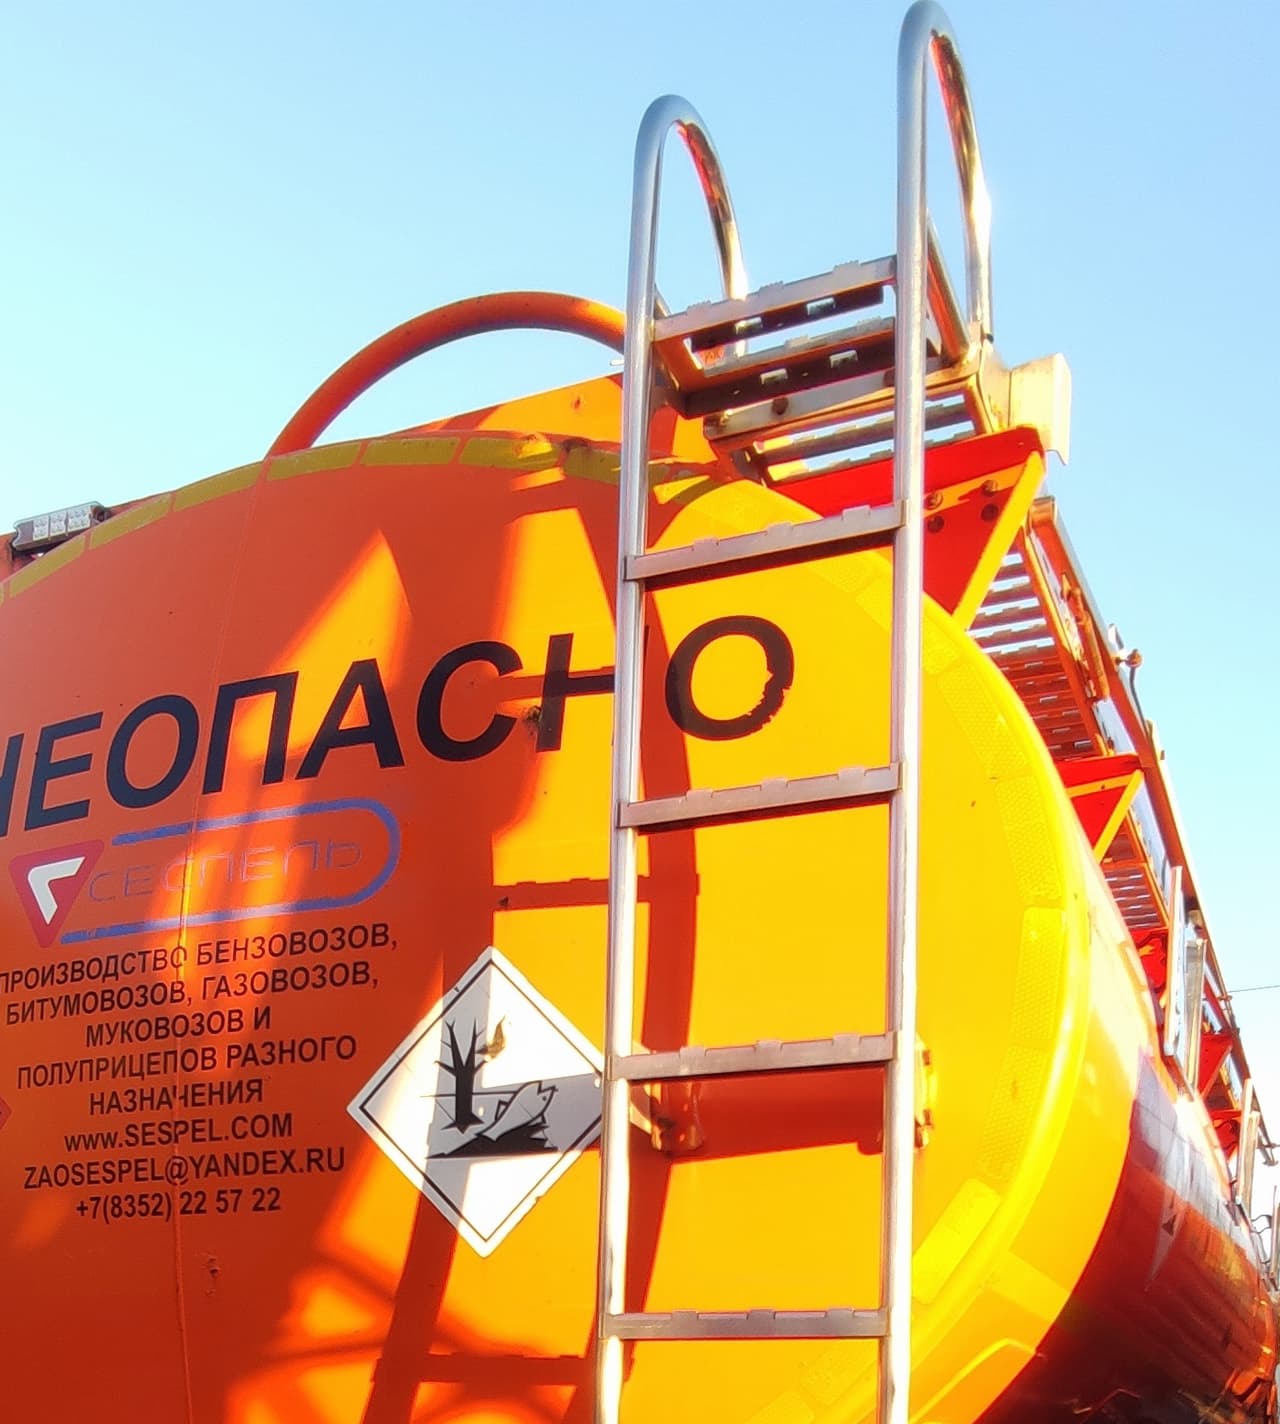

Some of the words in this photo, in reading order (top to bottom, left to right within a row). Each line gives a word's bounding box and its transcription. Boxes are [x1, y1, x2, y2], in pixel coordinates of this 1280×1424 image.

[196, 922, 398, 965] БЕНЗОВОЗОВ,
[6, 981, 193, 1025] БИТУМОВОЗОВ,
[201, 960, 379, 1000] ГАЗОВОЗОВ,
[85, 1009, 244, 1048] МУКОВОЗОВ
[254, 1005, 272, 1030] И
[17, 1046, 218, 1090] ПОЛУПРИЦЕПОВ
[226, 1034, 358, 1069] РАЗНОГО
[89, 1078, 264, 1116] НАЗНАЧЕНИЯ
[64, 1113, 294, 1153] www.SESPEL.COM
[23, 1147, 346, 1190] ZAOSESPEL@YANDEX.RU
[76, 1193, 173, 1224] +7(8352)
[179, 1190, 208, 1216] 22
[216, 1188, 243, 1214] 57
[252, 1187, 282, 1213] 22
